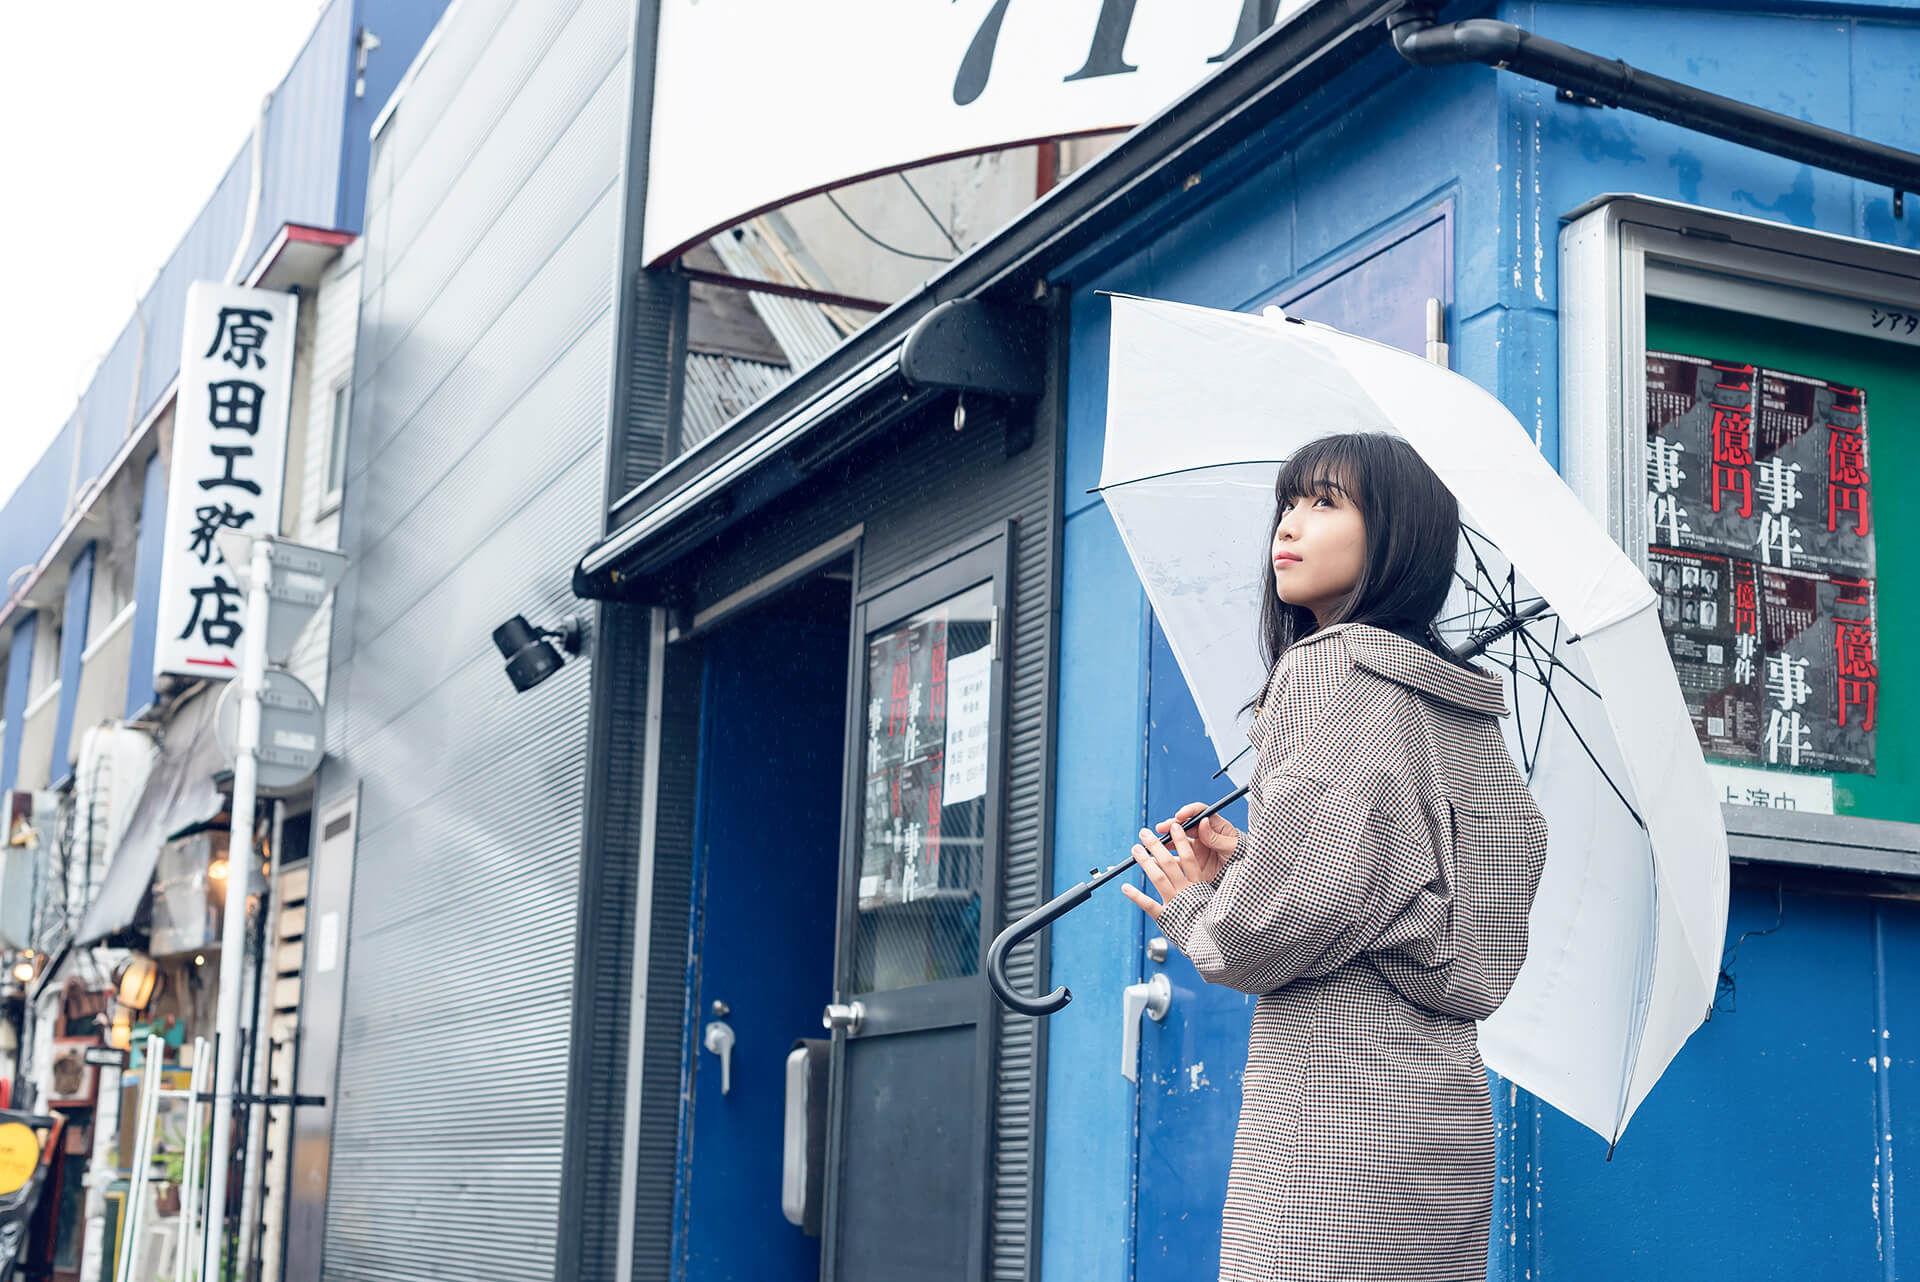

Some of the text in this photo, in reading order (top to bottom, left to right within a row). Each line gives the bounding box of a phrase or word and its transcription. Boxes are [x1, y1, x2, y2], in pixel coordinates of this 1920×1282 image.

[1872, 308, 1919, 336] シアタ
[179, 306, 274, 648] 原田工務店
[1647, 436, 1691, 547] 事件
[1709, 364, 1755, 518] 三億円
[1827, 386, 1869, 537] 三億円
[1755, 456, 1803, 568] 事件
[1763, 652, 1813, 766] 事件
[1831, 577, 1878, 732] 三億円
